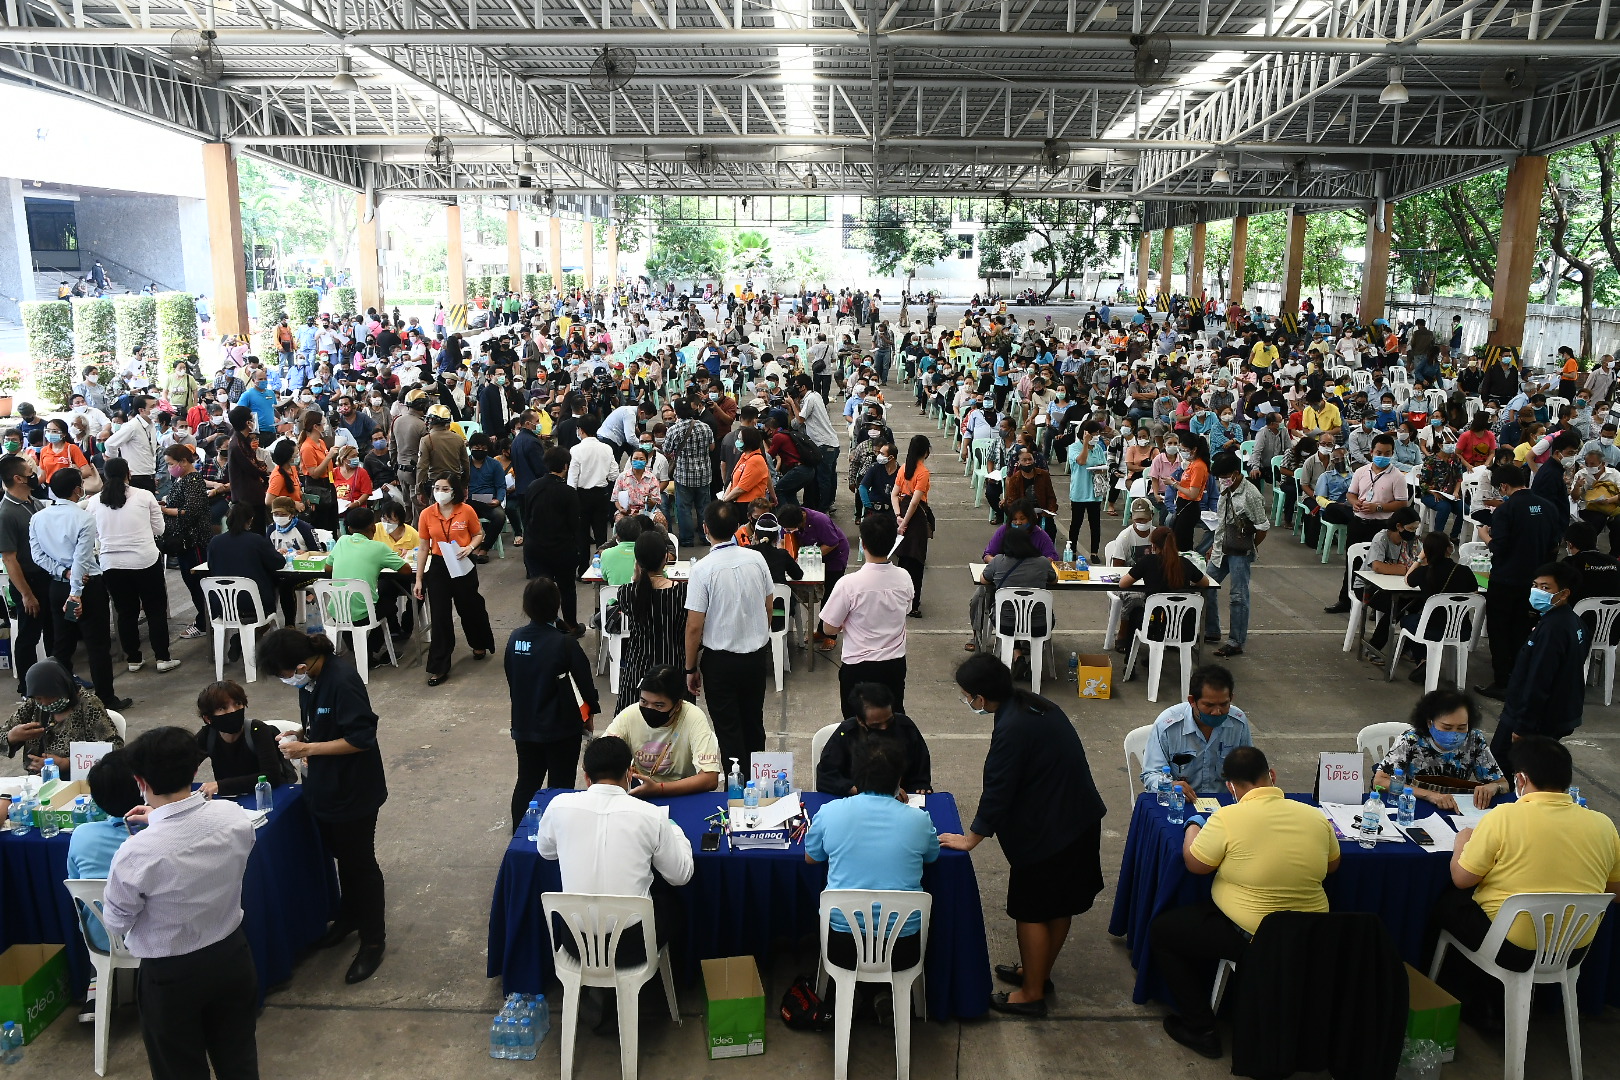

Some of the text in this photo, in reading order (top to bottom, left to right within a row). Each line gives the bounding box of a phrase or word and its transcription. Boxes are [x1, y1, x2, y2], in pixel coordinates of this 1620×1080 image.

[514, 640, 531, 651] MOF
[1325, 764, 1359, 780] โต๊ะ6
[27, 990, 55, 1023] idea
[712, 1036, 734, 1045] idea
